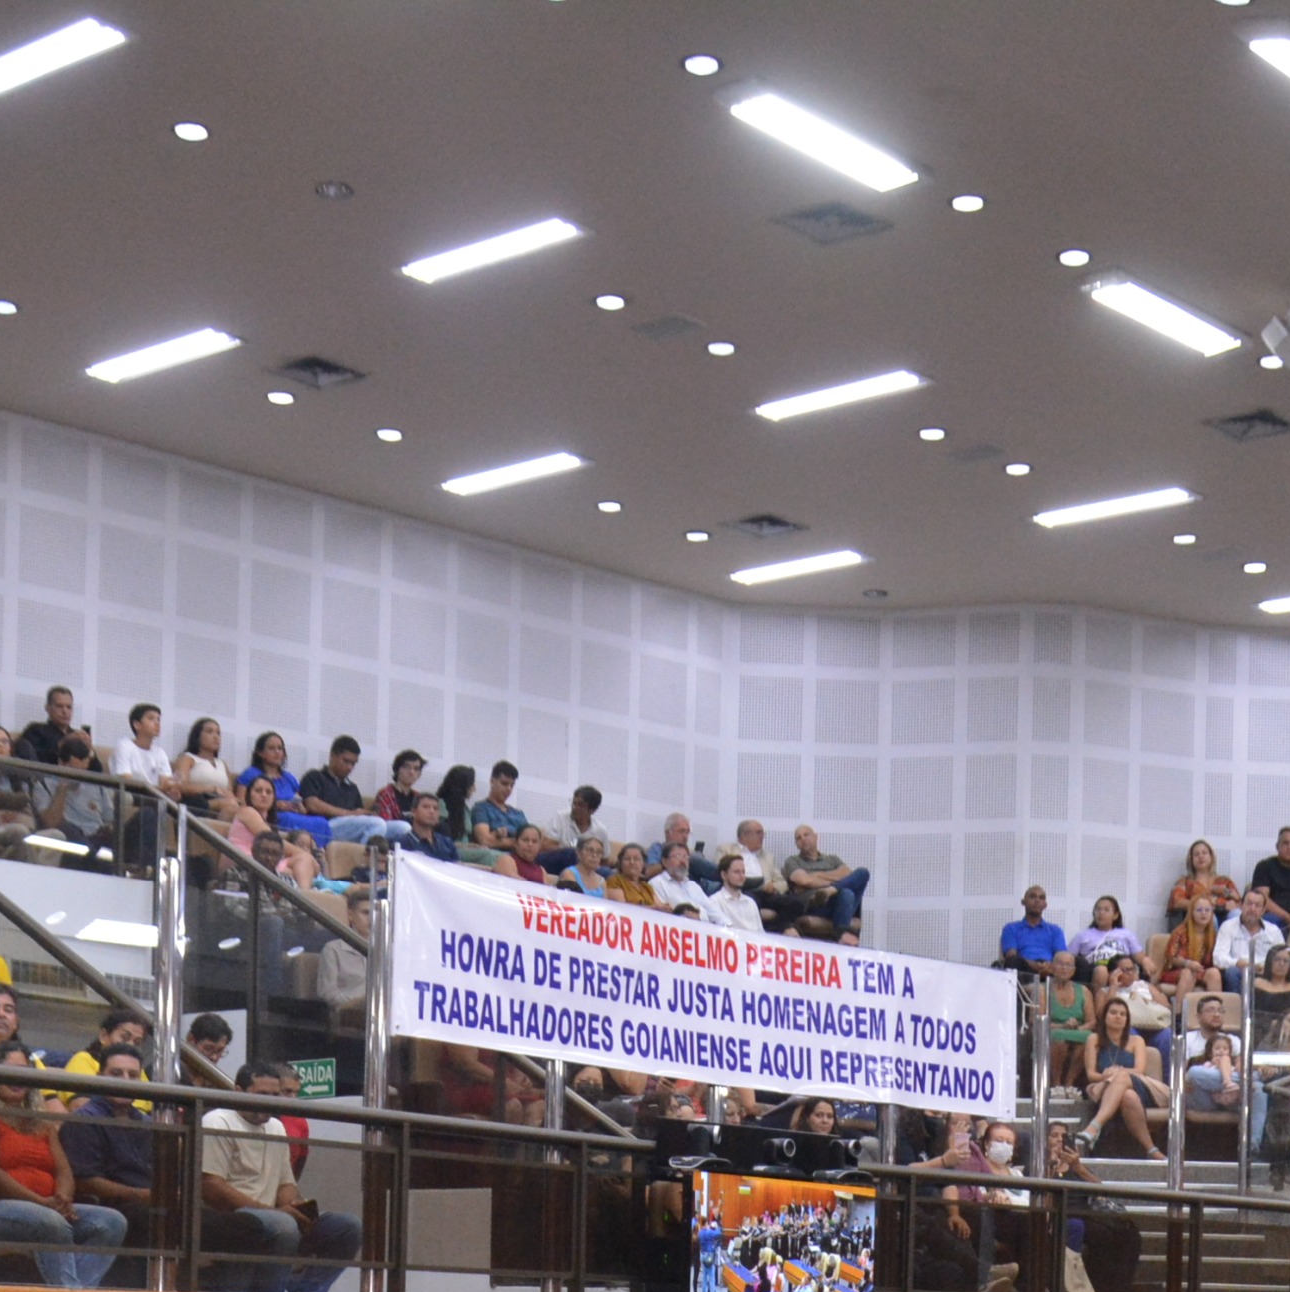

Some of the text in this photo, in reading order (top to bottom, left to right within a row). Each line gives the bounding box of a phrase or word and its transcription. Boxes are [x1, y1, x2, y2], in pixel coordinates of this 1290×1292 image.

[440, 928, 977, 1055] HONRA DE PRESTAR JUSTA HOMENAGEM A TODOS
[517, 892, 915, 999] VEREADOR ANSELMO PEREIRA TEM A
[298, 1062, 333, 1083] SAÍDA
[413, 980, 995, 1103] TRABALHADORES GOIANIENSE AQUI REPRESENTANDO
